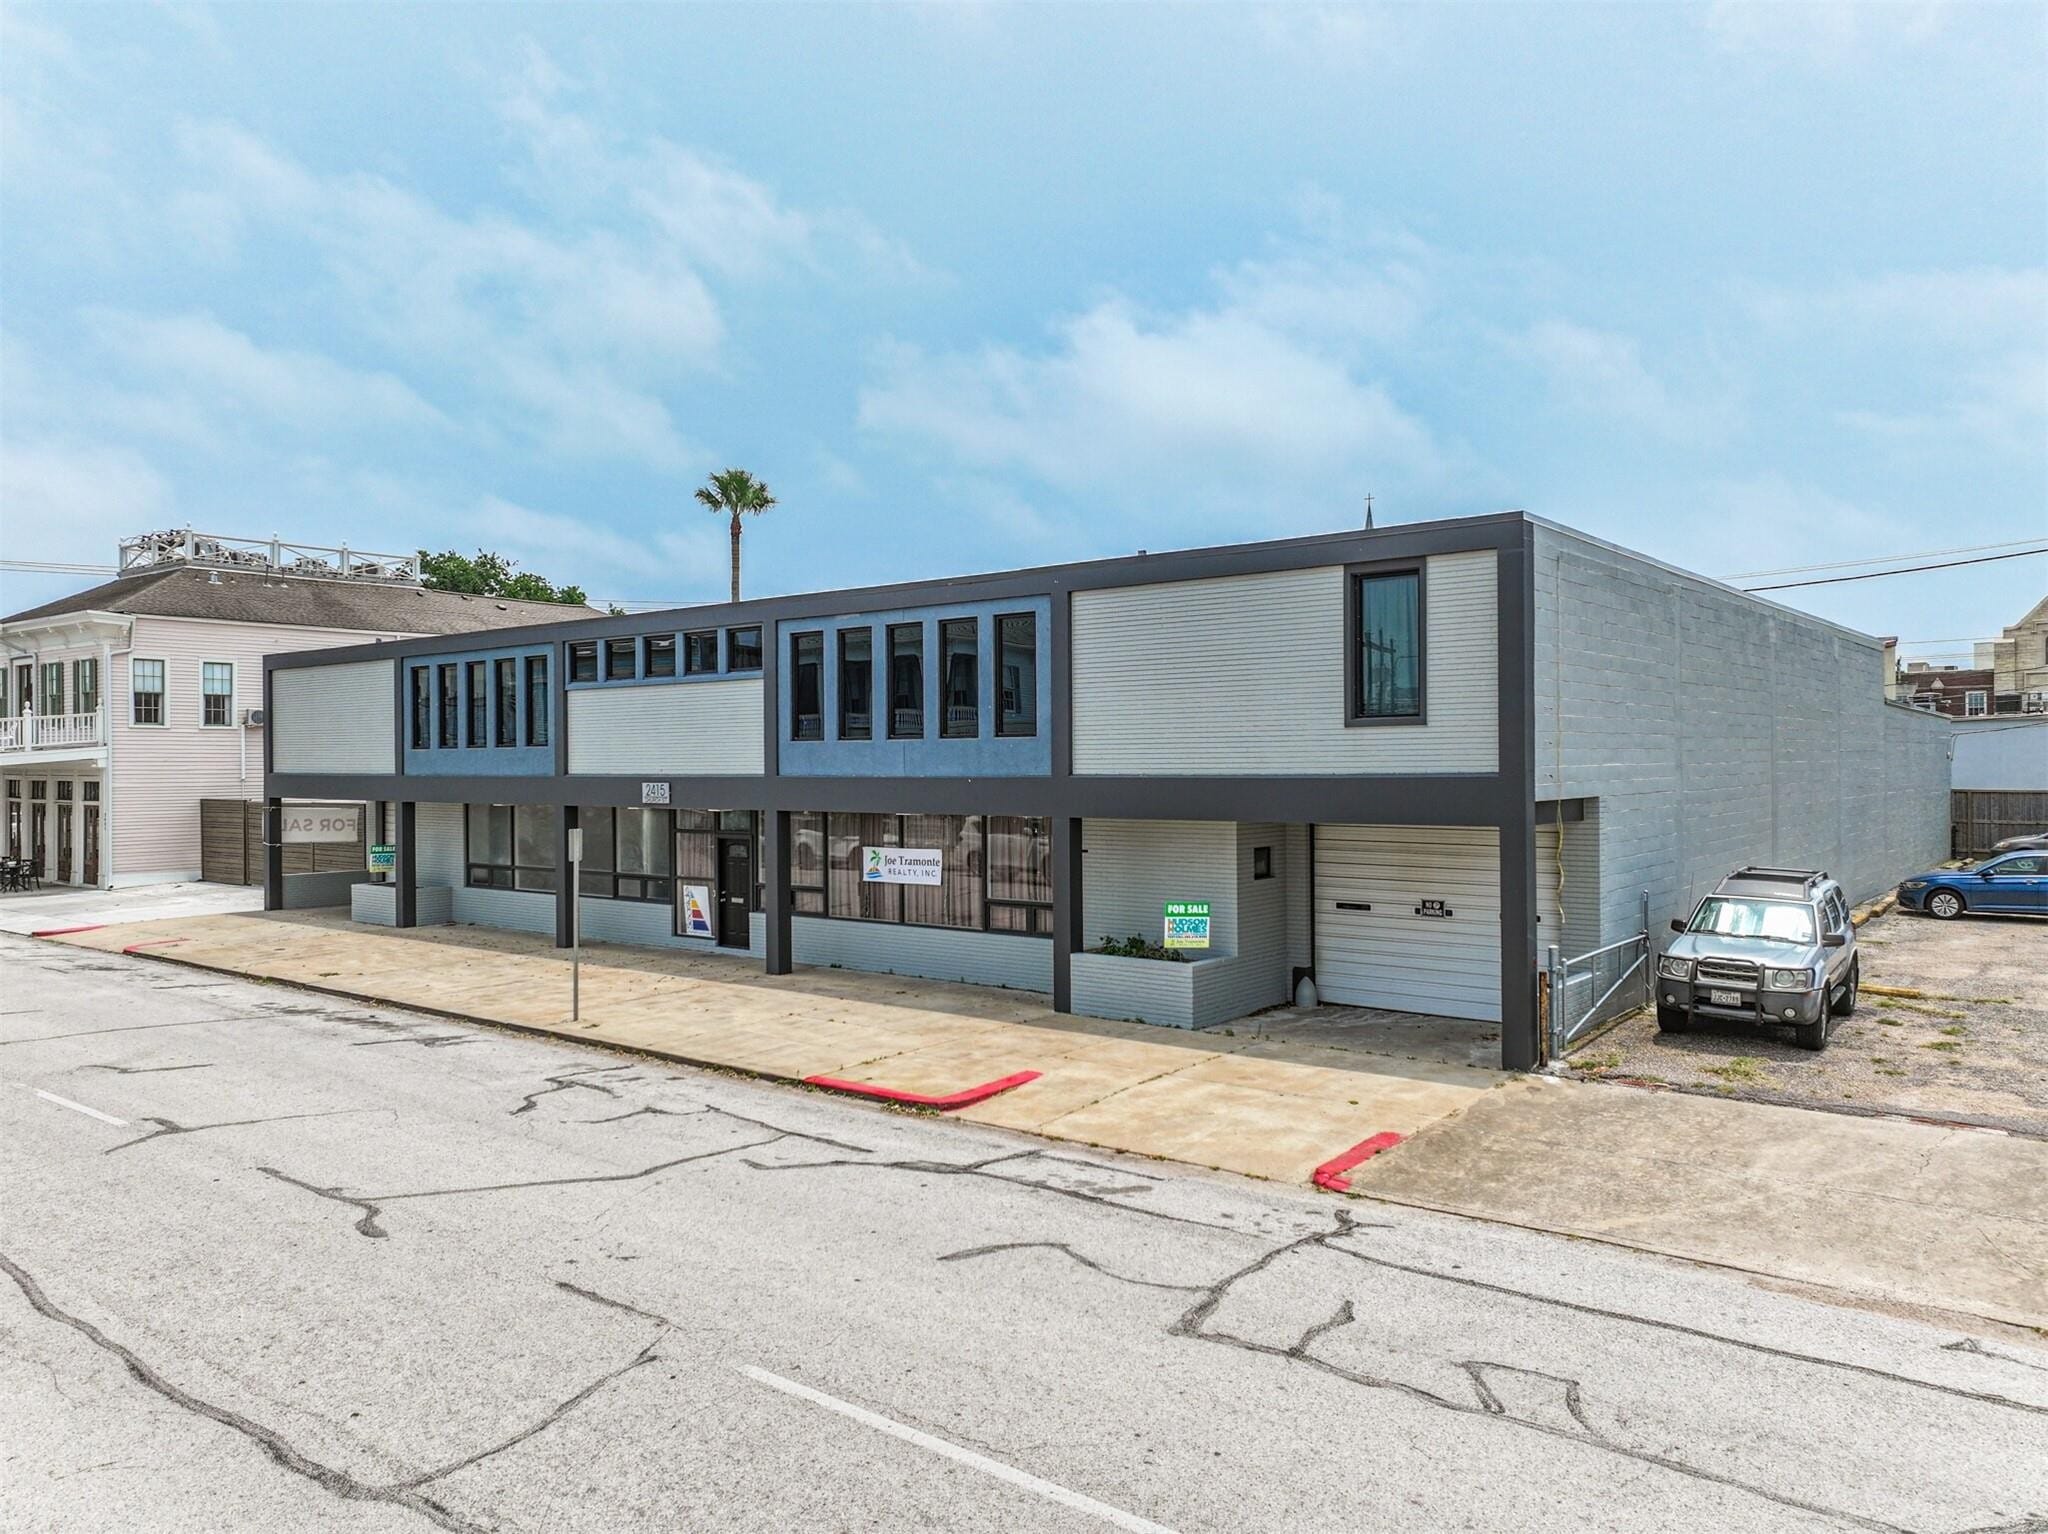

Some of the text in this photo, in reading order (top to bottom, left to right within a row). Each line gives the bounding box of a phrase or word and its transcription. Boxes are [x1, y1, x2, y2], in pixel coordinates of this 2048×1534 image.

[646, 783, 666, 797] 2415
[884, 855, 941, 867] Joe Tramonte
[888, 868, 919, 878] REALTY,
[1167, 904, 1209, 914] FOR SALE
[1423, 908, 1443, 916] PARKING
[1167, 918, 1208, 926] HUDSON
[1167, 925, 1208, 933] HOLMES
